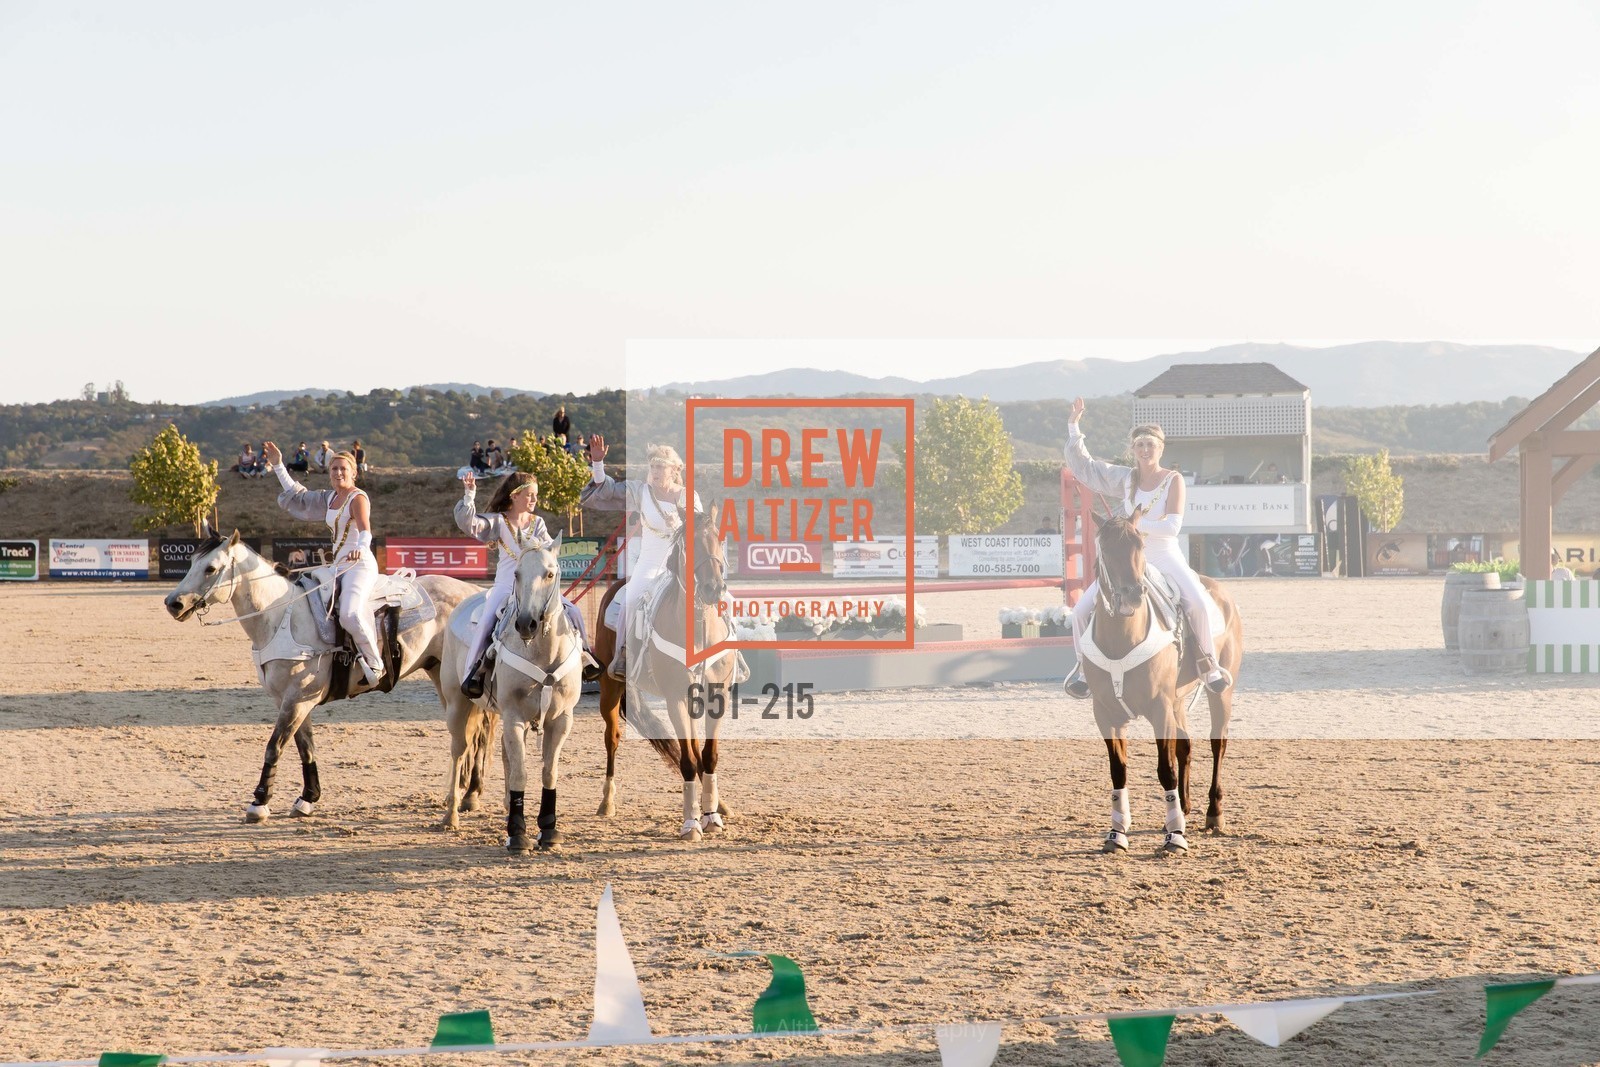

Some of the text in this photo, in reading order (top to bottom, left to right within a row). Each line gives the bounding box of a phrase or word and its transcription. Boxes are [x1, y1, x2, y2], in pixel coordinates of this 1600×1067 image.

[1189, 502, 1289, 511] THE PRIVATE BANK
[960, 537, 1052, 548] WEST COAST FOOTINGS
[1, 547, 29, 557] Track
[56, 549, 78, 557] Valley
[161, 544, 195, 554] GOOD
[52, 556, 96, 564] Commodities
[395, 551, 478, 564] TESLA
[751, 548, 802, 565] CWD
[61, 569, 136, 577] www.cvcshavings.com
[972, 564, 1041, 573] 800-585-7000
